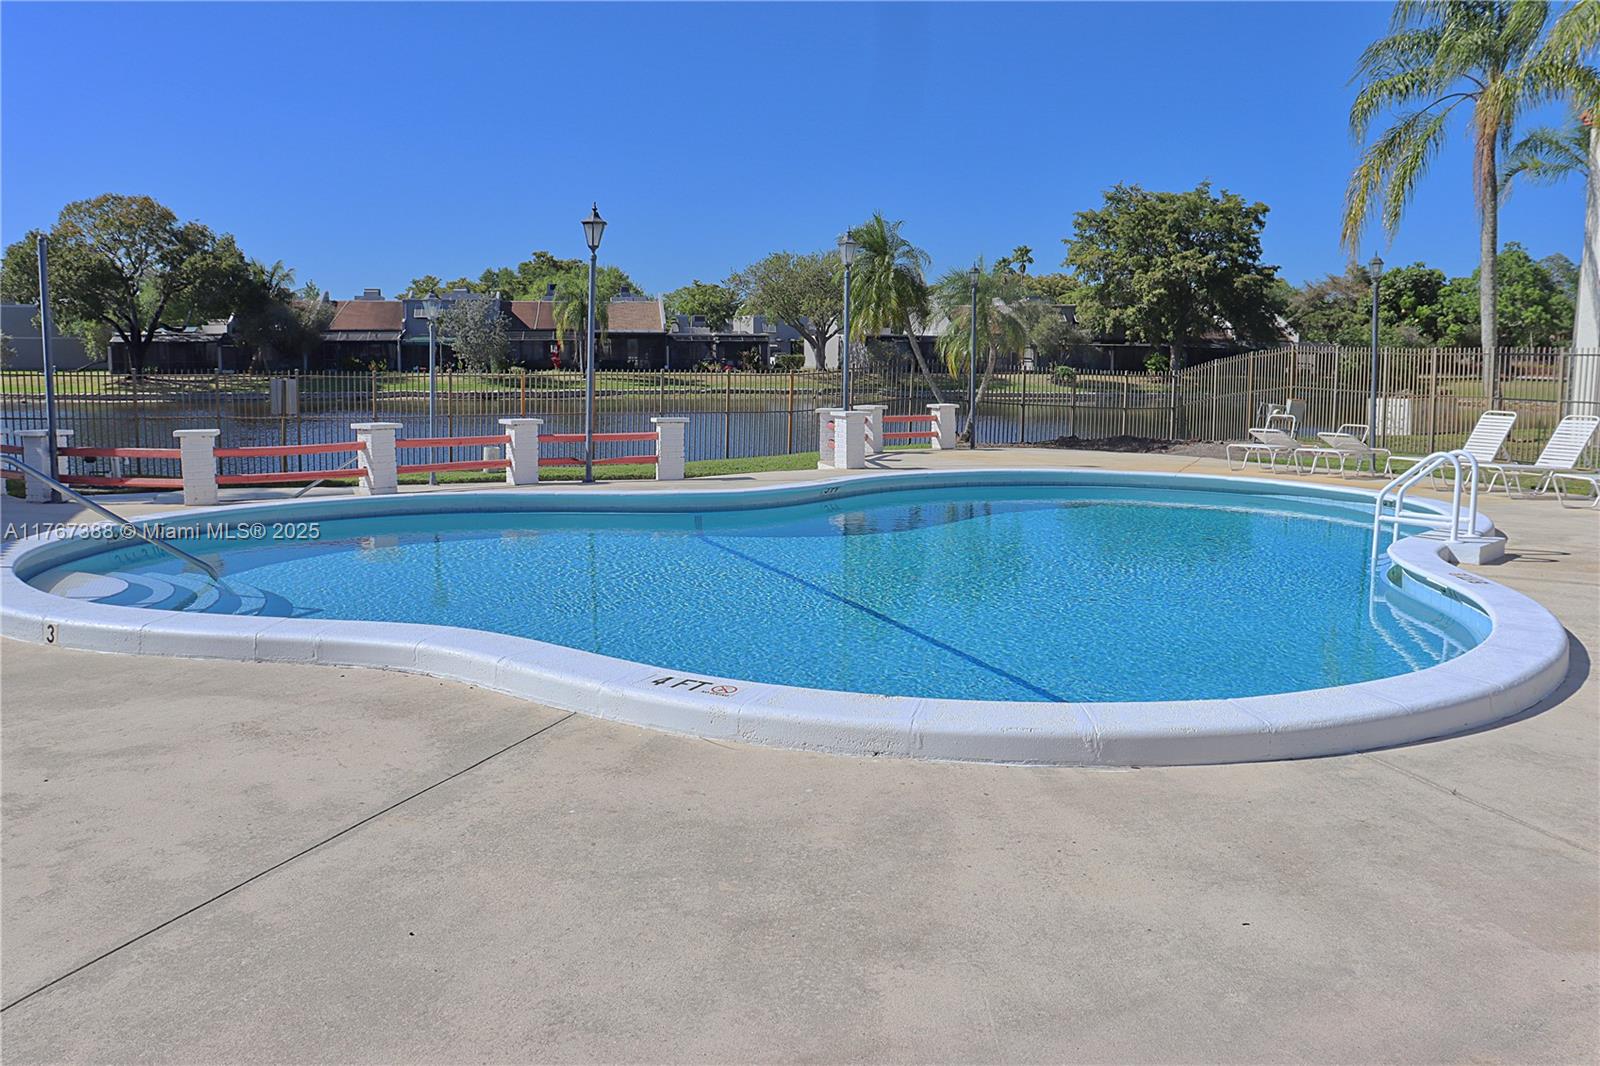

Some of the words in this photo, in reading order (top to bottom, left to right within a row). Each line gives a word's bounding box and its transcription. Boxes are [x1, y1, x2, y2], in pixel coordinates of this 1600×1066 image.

[46, 624, 55, 643] 3
[652, 676, 674, 686] 4
[670, 678, 714, 692] FT
